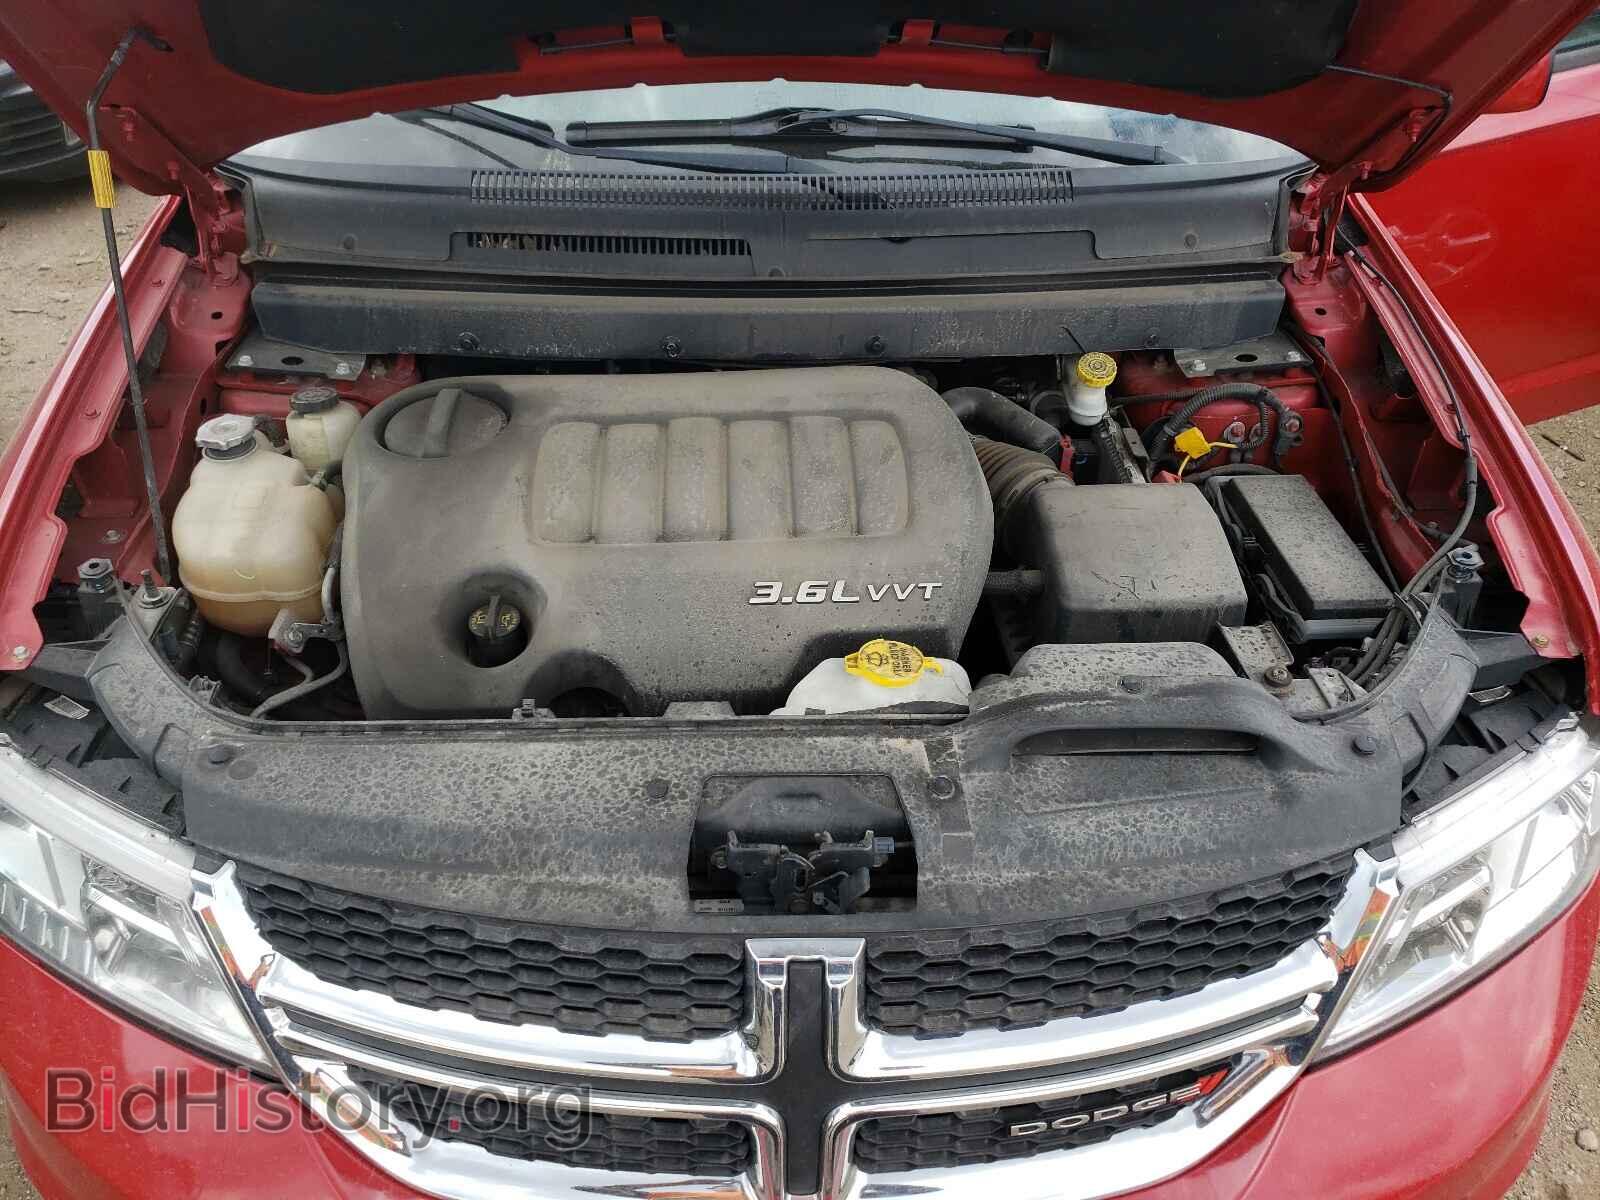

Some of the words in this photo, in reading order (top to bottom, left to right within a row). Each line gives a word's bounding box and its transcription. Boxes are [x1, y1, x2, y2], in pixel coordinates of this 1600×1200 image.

[748, 580, 860, 605] 3.6L
[867, 582, 943, 602] VVT
[1010, 1082, 1202, 1137] DODGE
